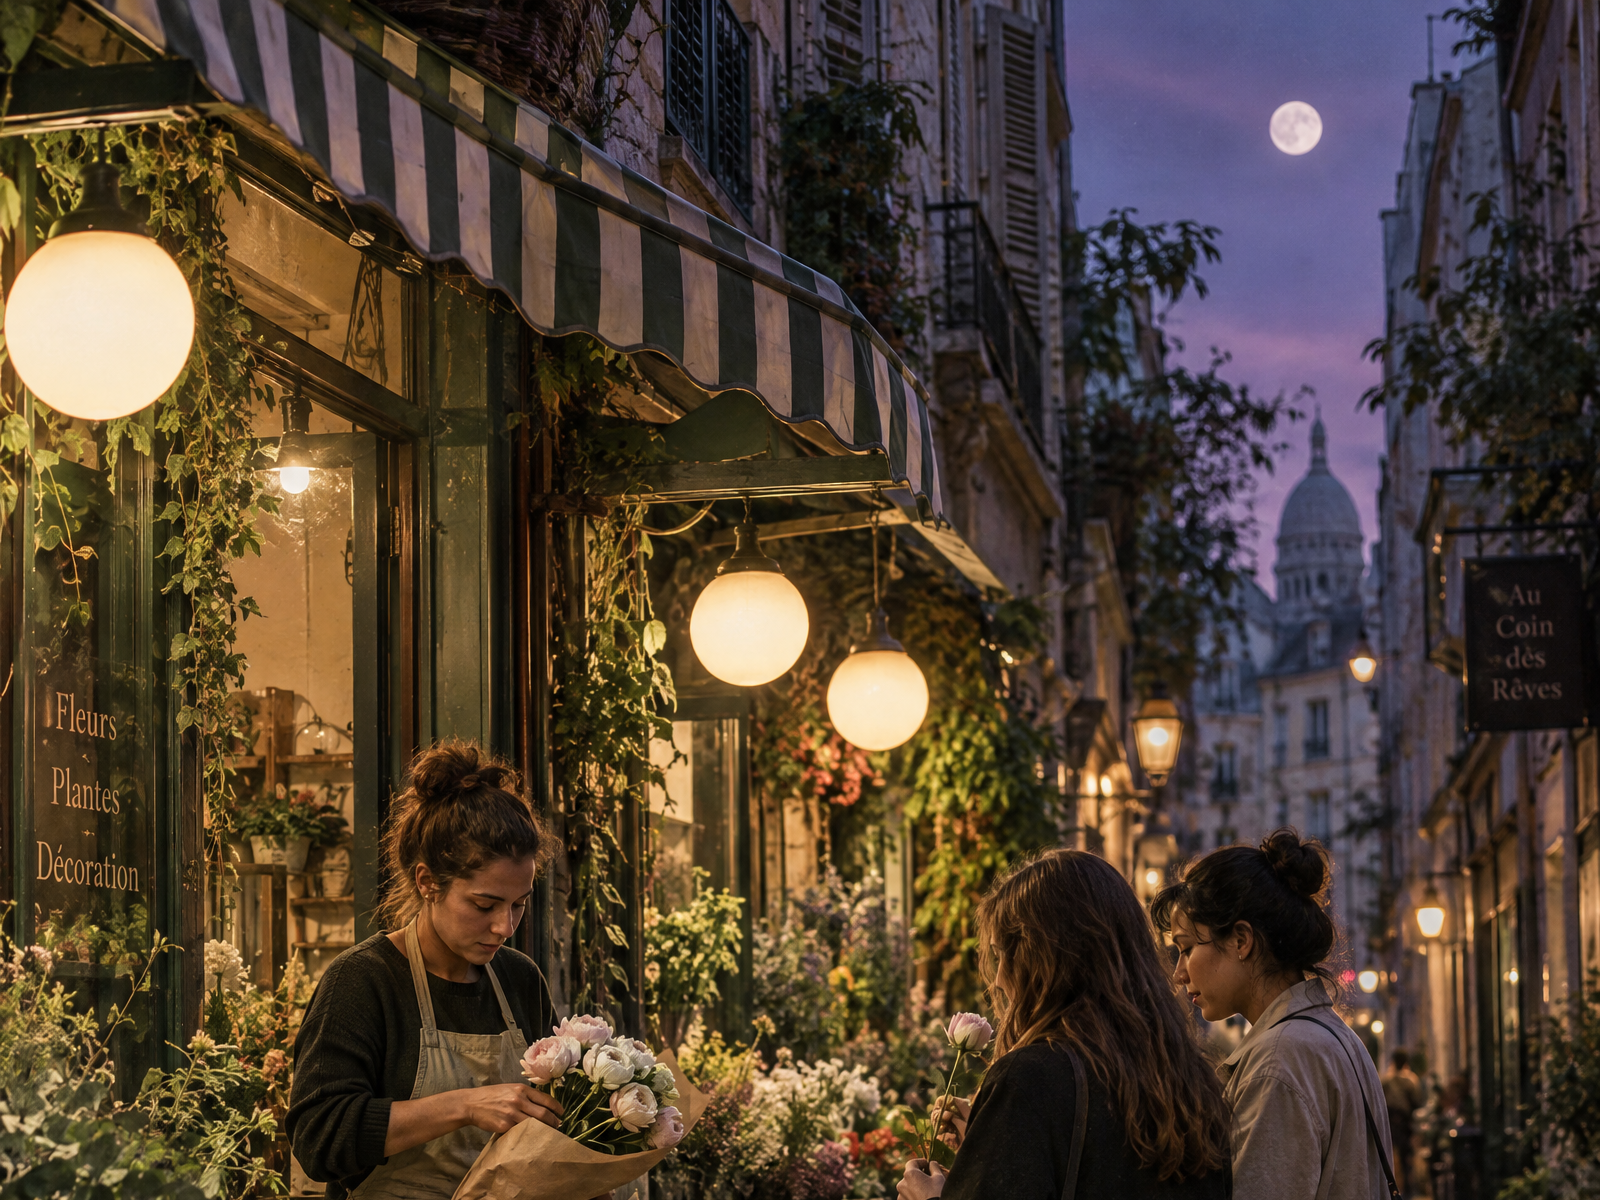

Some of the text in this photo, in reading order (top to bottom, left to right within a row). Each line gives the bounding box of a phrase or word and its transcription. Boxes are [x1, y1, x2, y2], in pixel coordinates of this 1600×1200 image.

[1508, 584, 1542, 607] Au
[1496, 614, 1554, 638] Coin
[1492, 678, 1562, 700] Rêves
[56, 691, 117, 741] Fleurs
[51, 766, 121, 815] Plantes
[36, 841, 139, 893] Décoration
